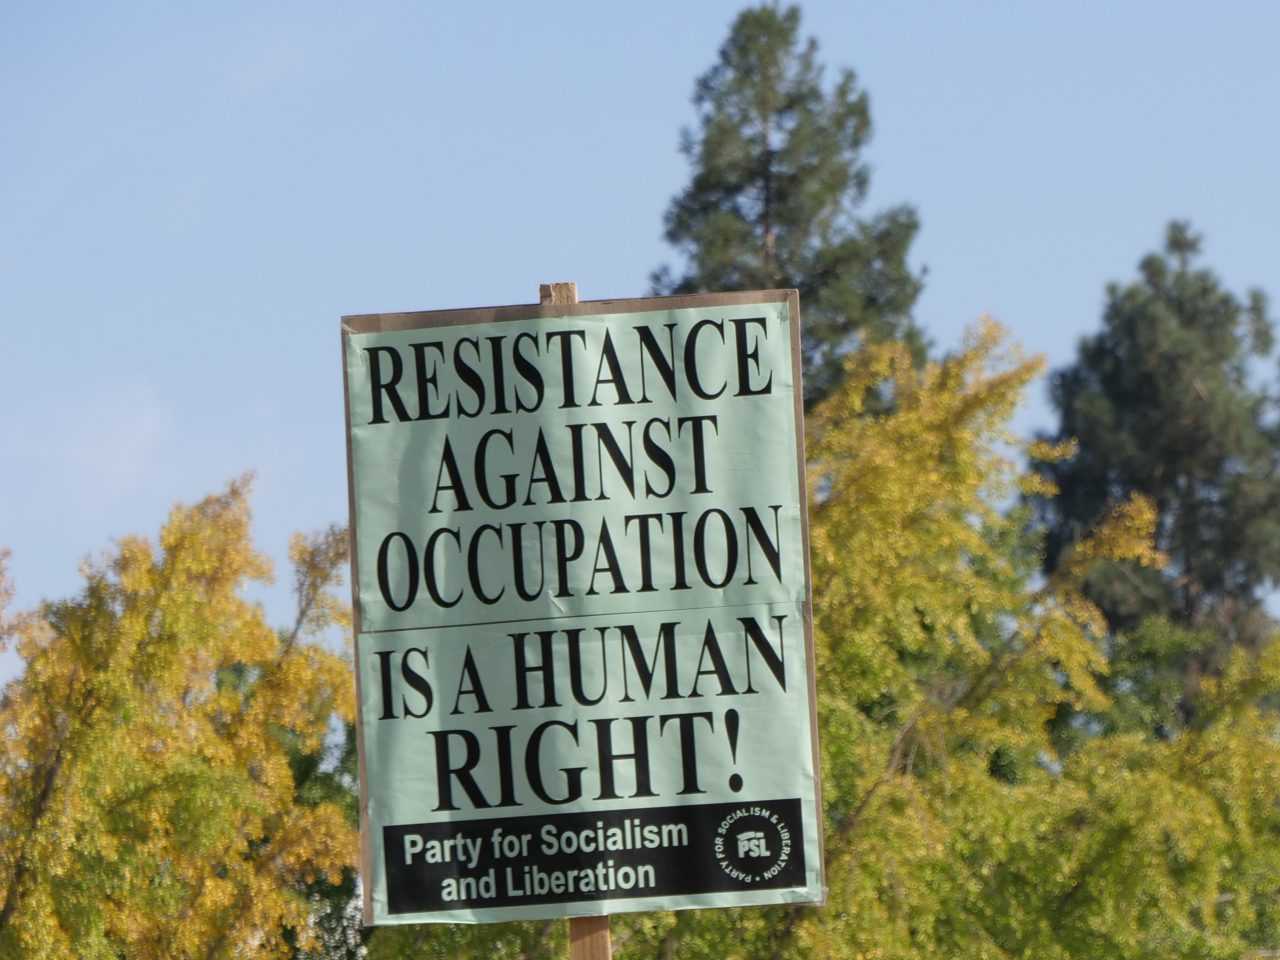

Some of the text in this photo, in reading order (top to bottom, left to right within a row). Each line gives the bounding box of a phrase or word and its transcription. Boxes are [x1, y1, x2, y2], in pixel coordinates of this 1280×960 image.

[366, 317, 773, 425] RESISTANCE
[428, 415, 719, 514] AGAINST
[376, 504, 783, 612] OCCUPATION
[374, 614, 788, 720] IS A HUMAN
[427, 709, 744, 812] RIGHT!
[403, 818, 689, 868] Party for Socialism
[714, 837, 725, 859] FOR
[718, 807, 770, 835] SOCIALISM
[738, 838, 771, 858] PSL
[719, 860, 752, 883] PARTY
[763, 822, 791, 880] LIBERATION
[441, 859, 656, 901] and Liberation
